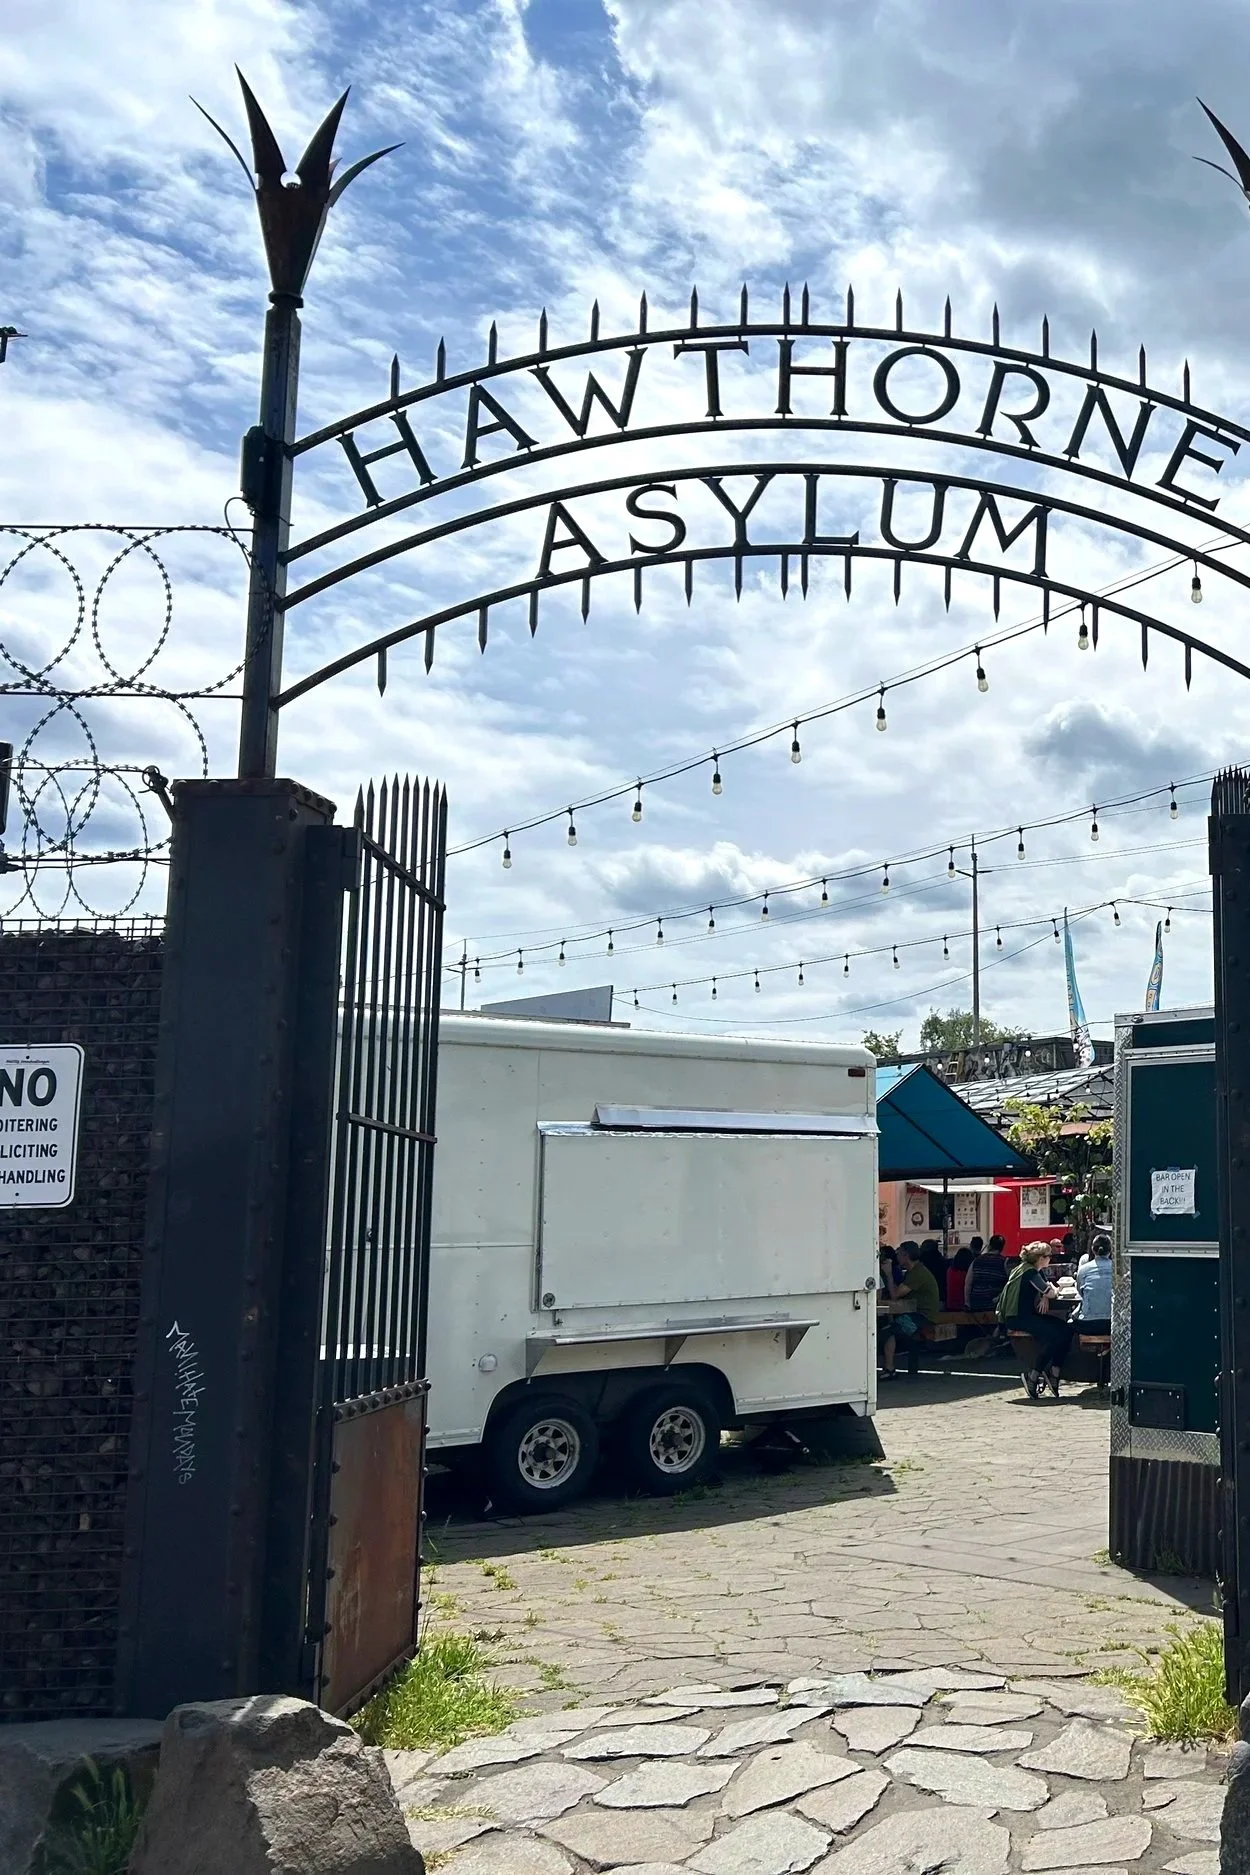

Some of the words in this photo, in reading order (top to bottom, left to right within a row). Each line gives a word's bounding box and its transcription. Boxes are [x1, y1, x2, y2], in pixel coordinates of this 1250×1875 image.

[336, 338, 1241, 512] HAWTHORNE
[535, 474, 1053, 578] ASYLUM
[0, 1067, 57, 1107] NO
[0, 1144, 58, 1158] LICITING
[1156, 1173, 1170, 1181] BAR
[1171, 1172, 1190, 1181] OPEN
[1161, 1185, 1169, 1193] IN
[1171, 1185, 1185, 1193] THE
